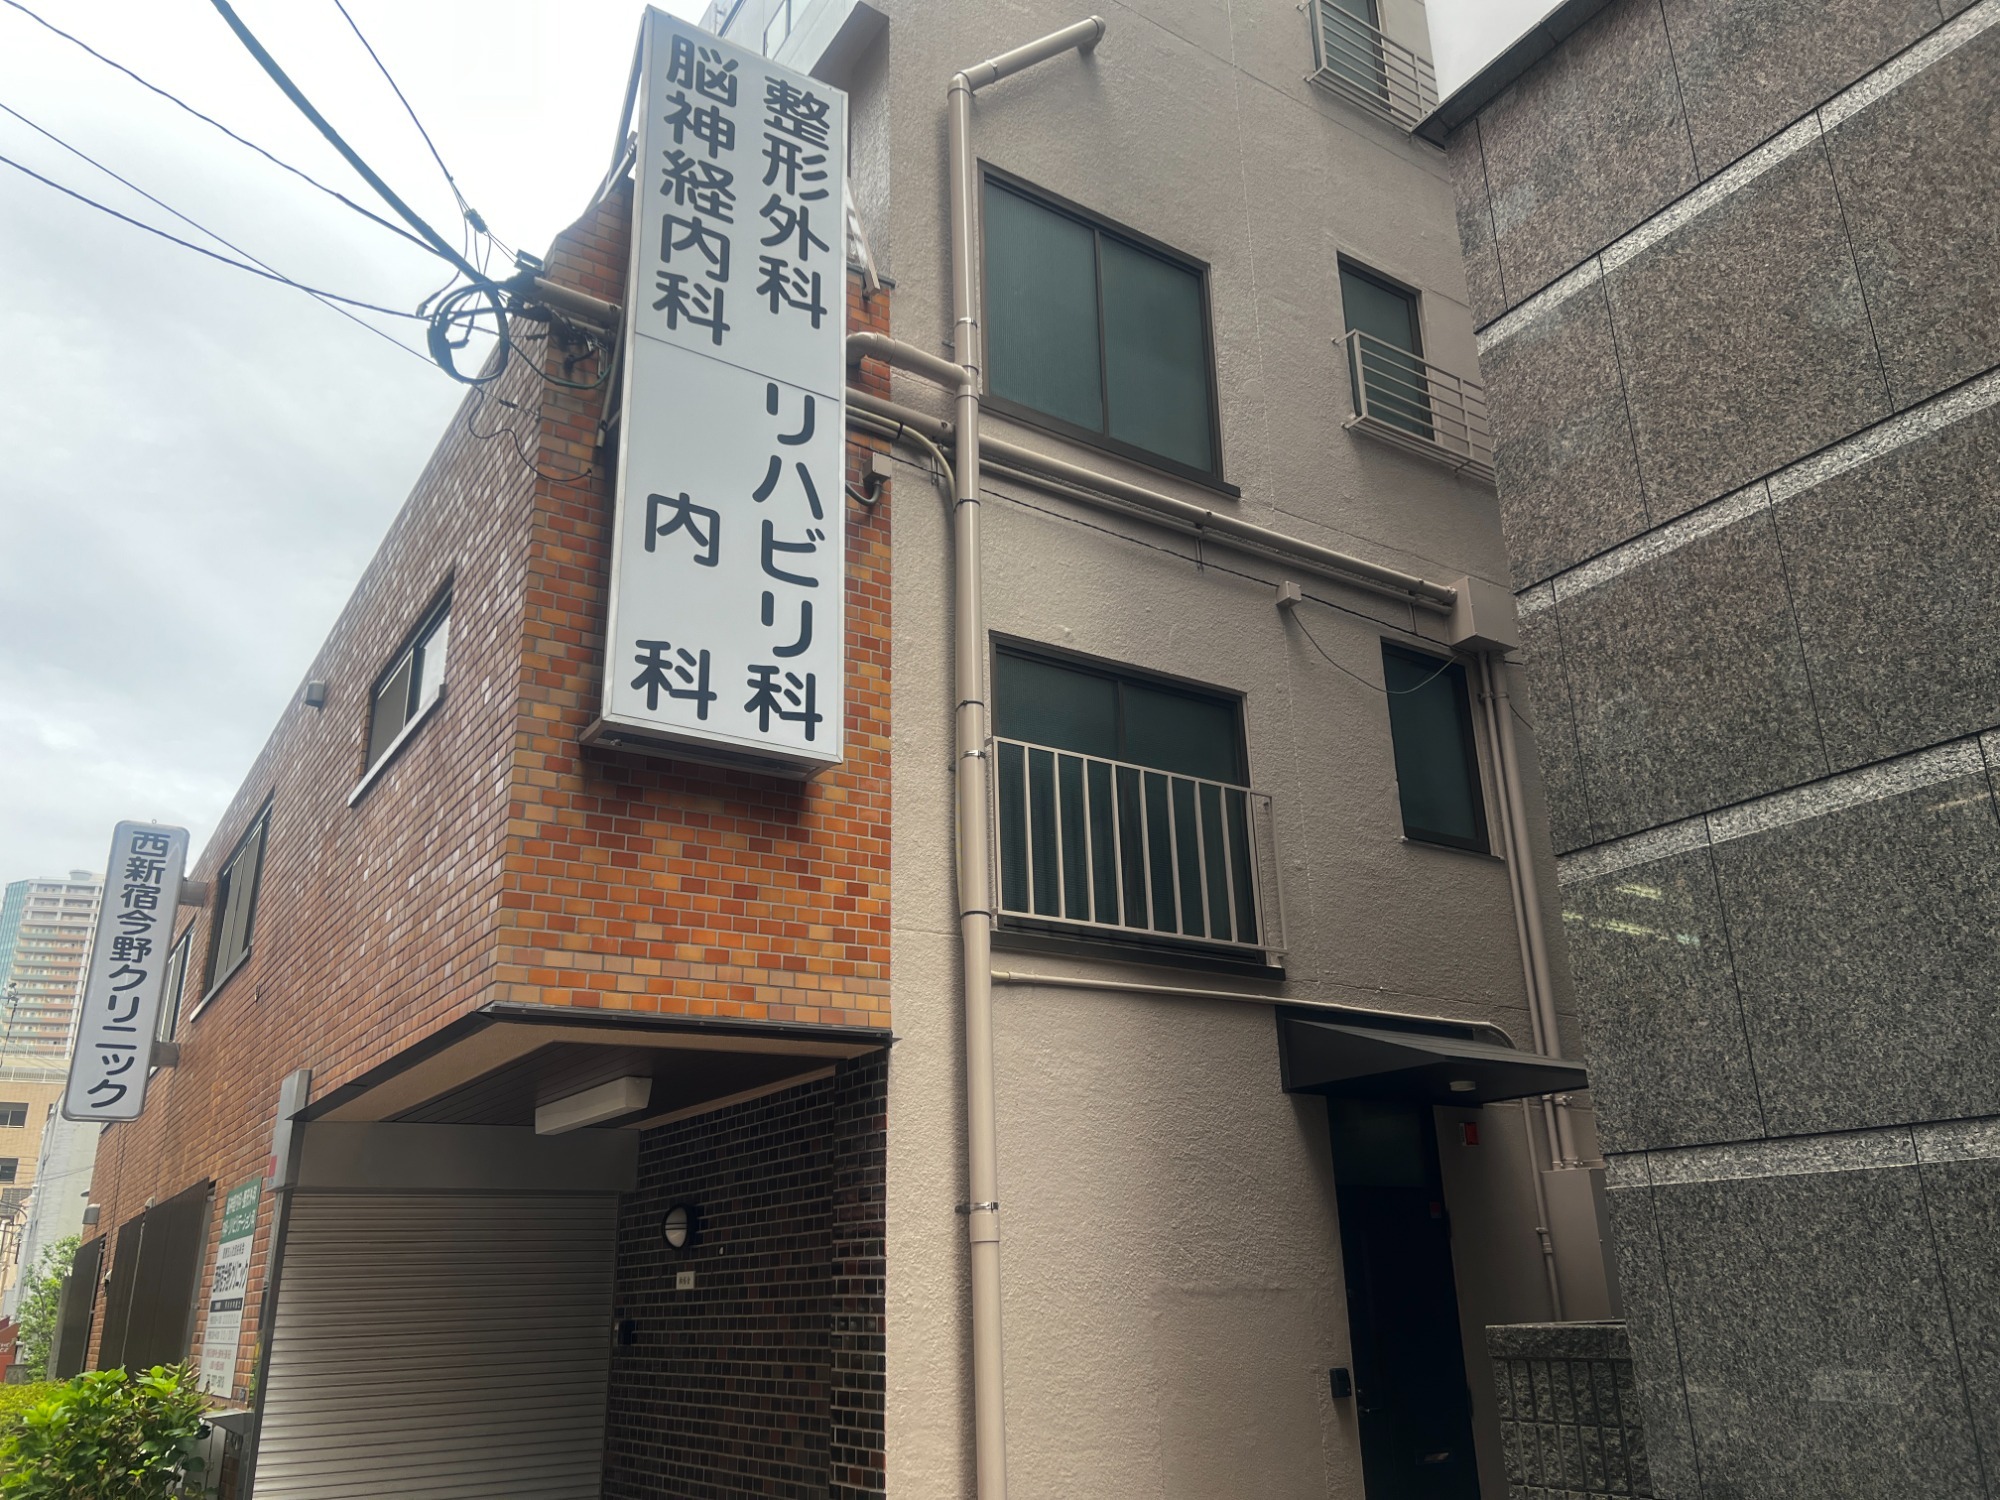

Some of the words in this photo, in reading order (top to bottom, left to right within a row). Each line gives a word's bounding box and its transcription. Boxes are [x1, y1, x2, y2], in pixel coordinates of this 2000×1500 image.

[652, 34, 739, 346] 脳神経内科
[756, 75, 830, 330] 整形外科
[630, 492, 720, 721] 内科
[744, 382, 825, 741] リハビリ科
[87, 830, 171, 1109] 西新宿今野クリニック
